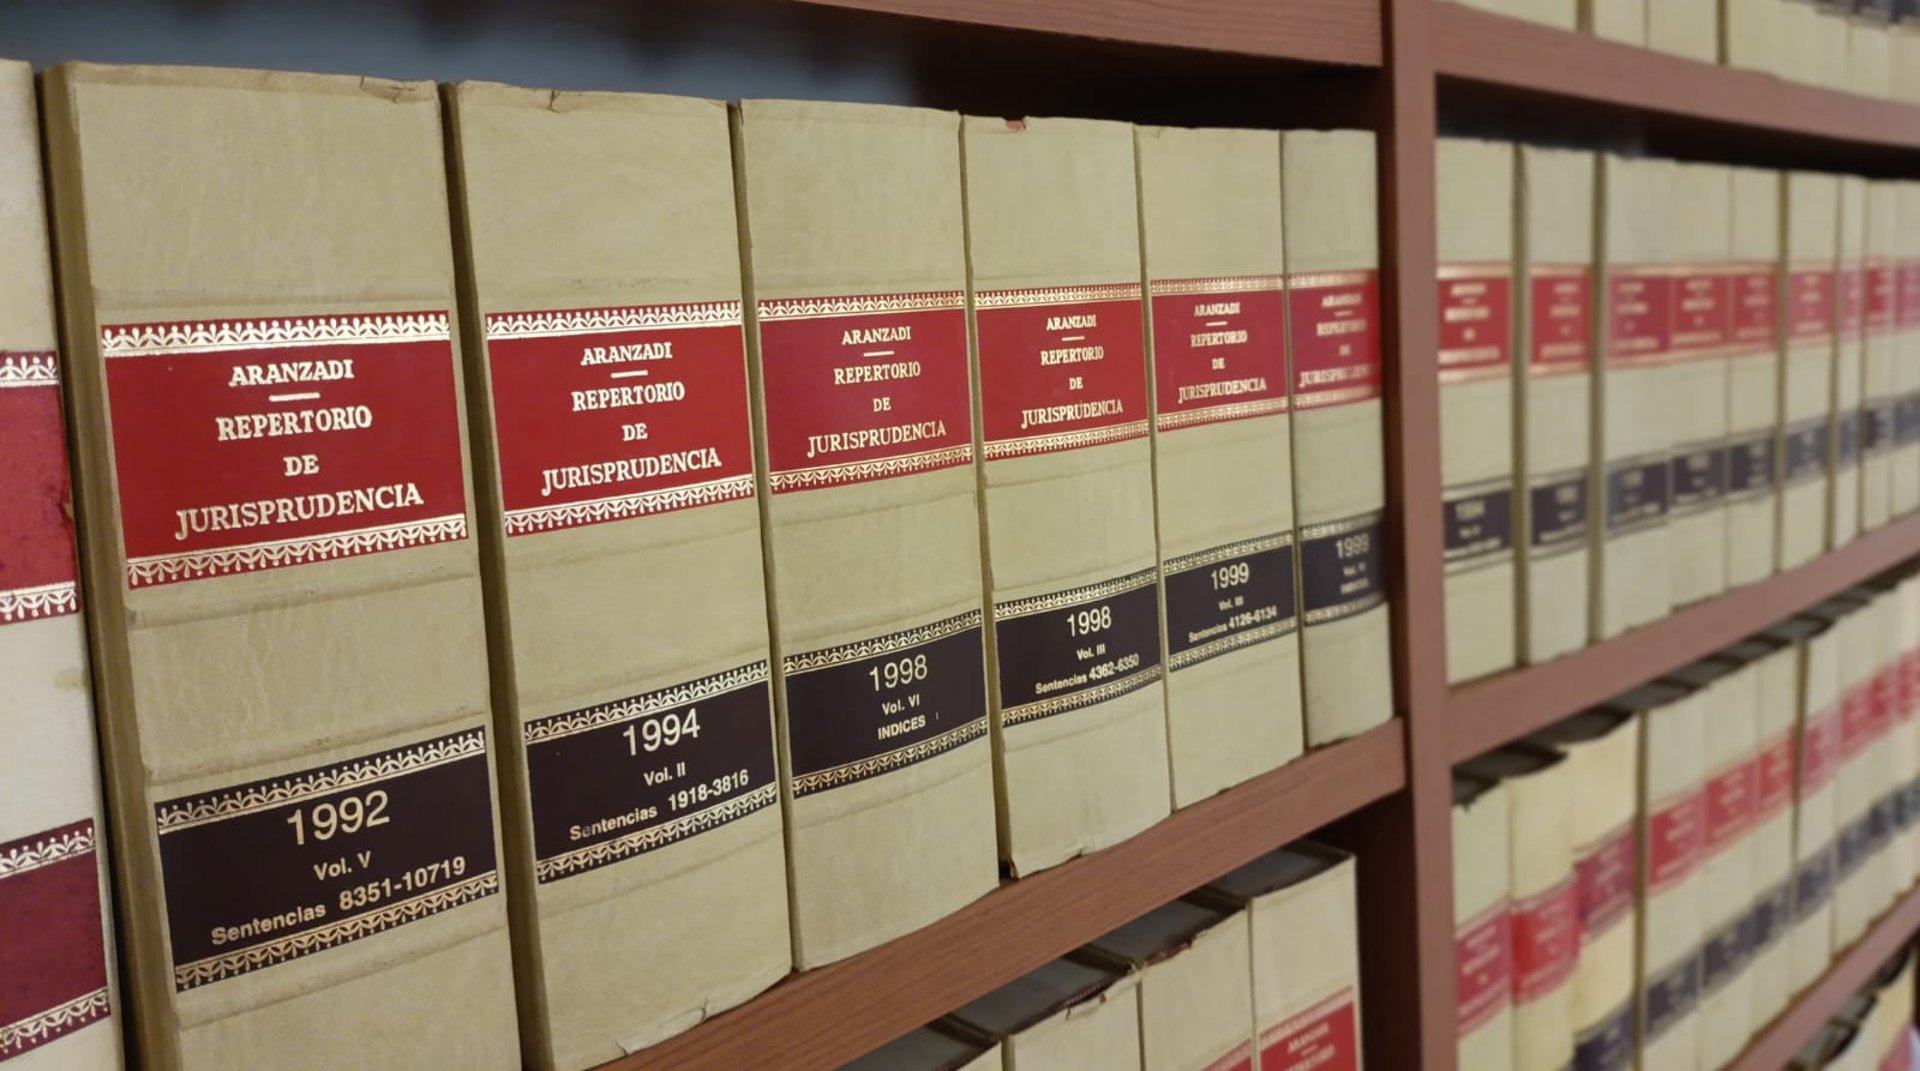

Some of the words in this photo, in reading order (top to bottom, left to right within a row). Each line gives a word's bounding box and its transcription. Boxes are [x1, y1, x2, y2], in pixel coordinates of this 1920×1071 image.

[1194, 302, 1241, 316] ARANZADI
[842, 326, 912, 345] ARANZADI
[1046, 315, 1097, 331] ARANZADI
[1190, 330, 1247, 348] REPERTORIO
[581, 342, 672, 366] ARANZADI
[1040, 346, 1104, 366] REPERTORIO
[1211, 357, 1225, 370] DE
[228, 359, 355, 387] ARANZADI
[834, 361, 921, 385] REPERTORIO
[1069, 377, 1083, 390] DE
[571, 381, 685, 412] REPERTORIO
[1178, 377, 1267, 403] JURISPRUDENCIA
[873, 397, 891, 412] DE
[1021, 399, 1123, 429] JURISPRUDENCIA
[216, 405, 373, 441] REPERTORIO
[622, 423, 648, 441] DE
[807, 420, 946, 458] JURISPRUDENCIA
[283, 454, 319, 477] DE
[541, 447, 722, 497] JURISPRUDENCIA
[174, 482, 424, 541] JURISPRUDENCIA
[1210, 562, 1249, 590] 1999
[1067, 605, 1112, 637] 1998
[1076, 647, 1094, 661] Vol.
[1096, 643, 1106, 655] III
[868, 654, 928, 692] 1998
[1035, 673, 1088, 695] Sentencias
[1089, 653, 1140, 681] 4362-6350
[881, 700, 905, 716] Vol.
[908, 693, 920, 708] VI
[623, 708, 701, 757] 1994
[877, 714, 926, 741] INDICES
[643, 767, 673, 787] Vol.
[676, 761, 686, 777] II
[287, 789, 390, 845] 1992
[569, 803, 658, 841] Sentencias
[667, 768, 749, 811] 1918-3816
[313, 853, 353, 881] Vol.
[357, 850, 372, 868] V
[210, 902, 327, 946] Sentencias
[338, 855, 466, 911] 8351-10719
